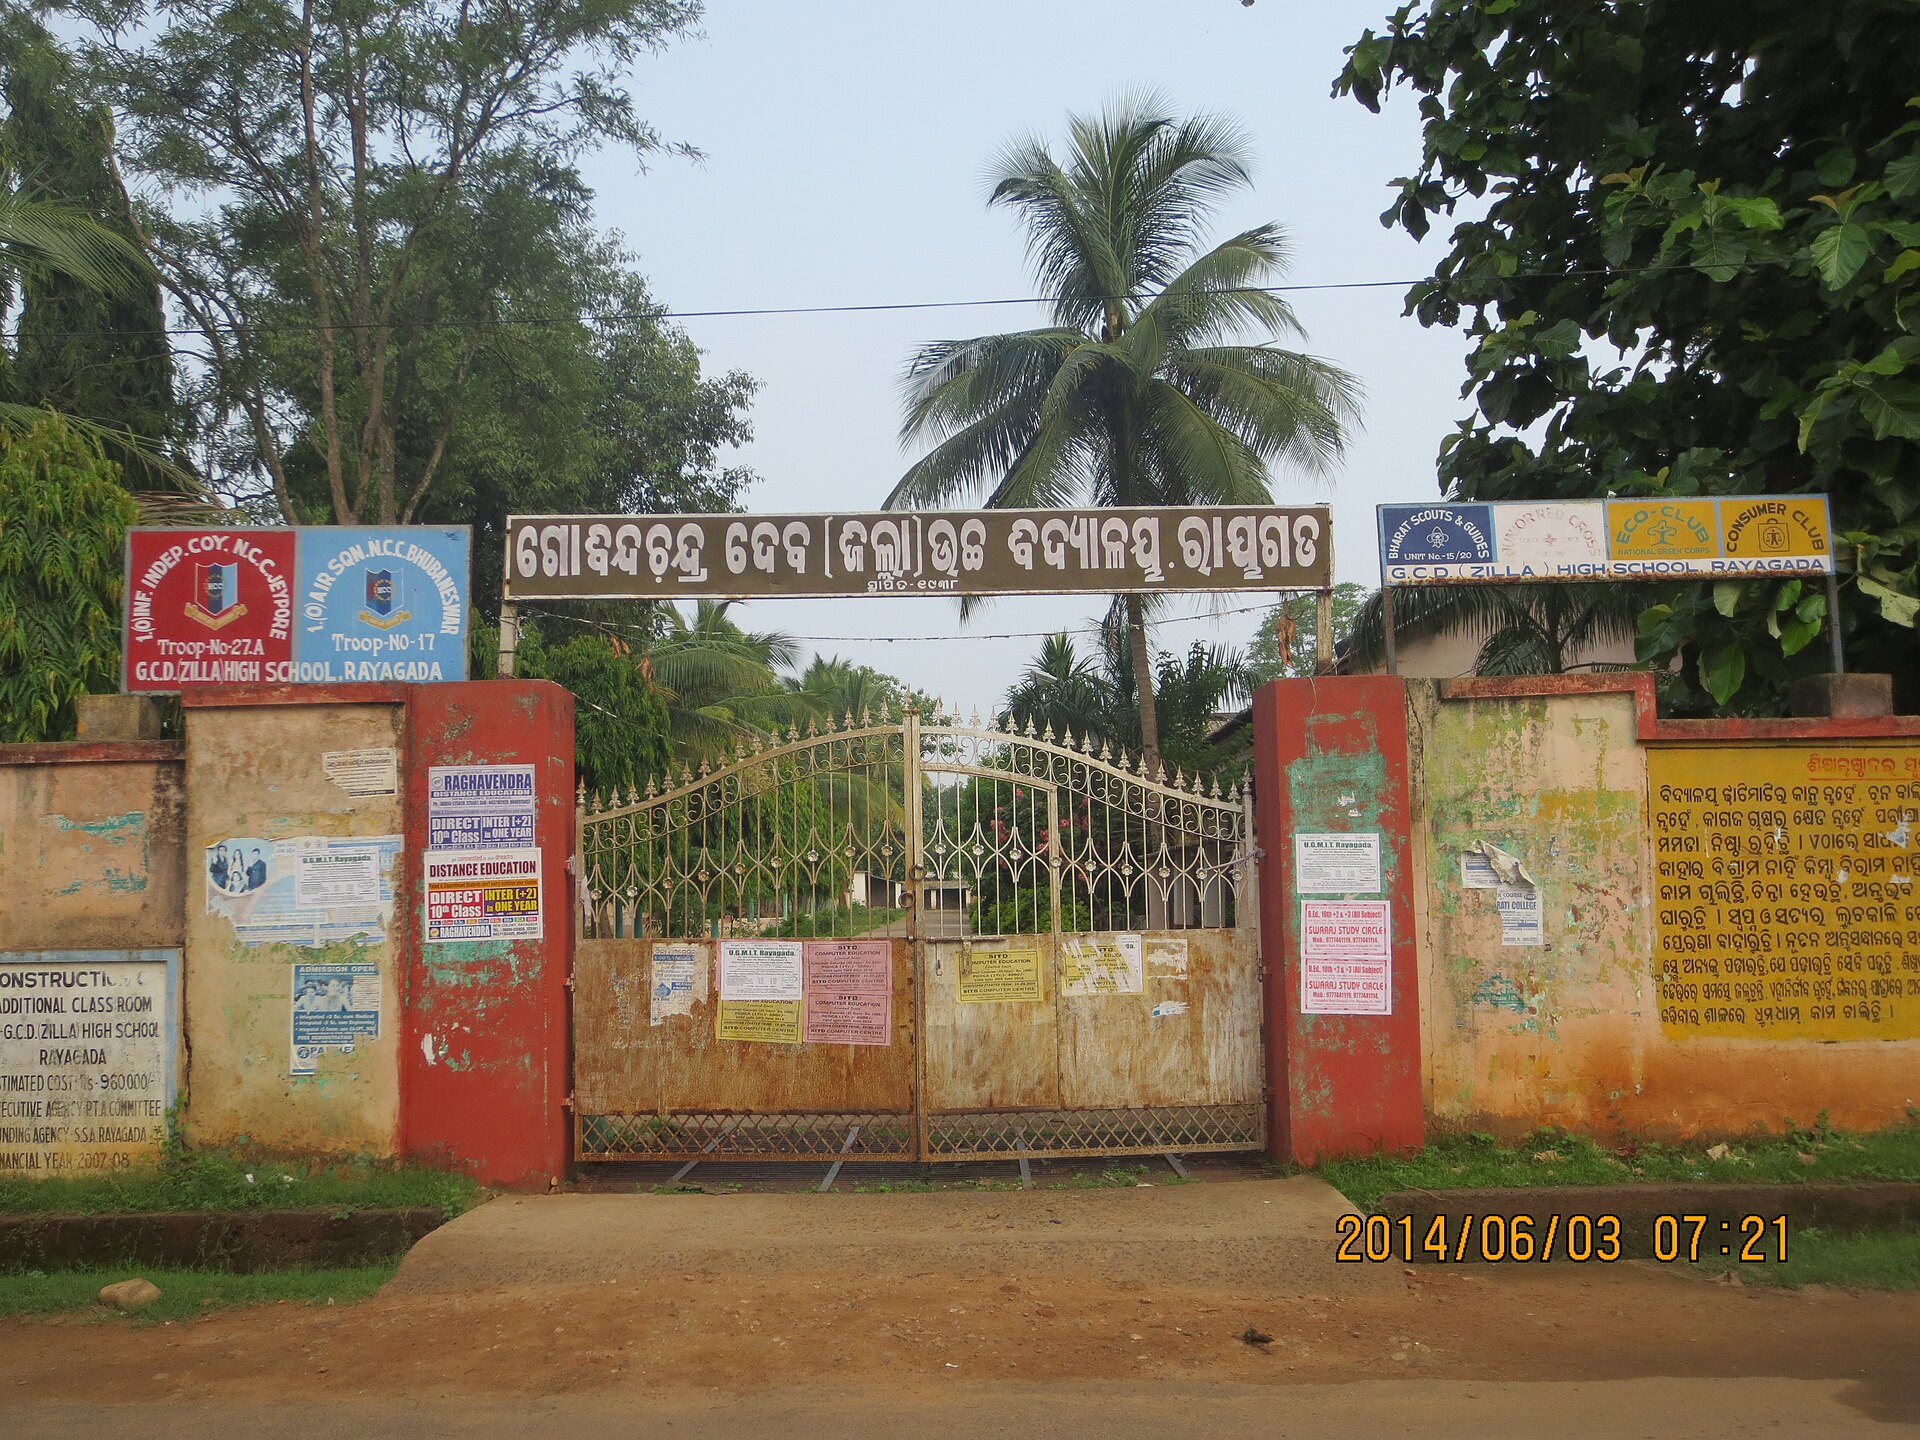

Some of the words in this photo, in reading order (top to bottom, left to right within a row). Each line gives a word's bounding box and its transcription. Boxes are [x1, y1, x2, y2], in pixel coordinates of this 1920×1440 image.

[1726, 502, 1787, 553] CONSUMER
[1792, 510, 1825, 551] CLUB
[1388, 520, 1412, 559] BHARAT
[1410, 509, 1454, 526] SCOUTS
[1454, 515, 1464, 527] &
[1463, 521, 1490, 559] GUIDES
[1404, 553, 1426, 561] UNIT
[1617, 548, 1654, 556] NATIONAL
[1684, 547, 1711, 555] CORPS
[1557, 563, 1607, 576] HIGH
[1711, 558, 1825, 573] RAYAGADA
[344, 661, 443, 681] RAYAGADA
[444, 773, 531, 789] RAGHAVENDRA
[432, 817, 480, 830] DIRECT
[482, 816, 509, 828] INTER
[453, 831, 480, 843] Class
[492, 828, 509, 838] ONE
[510, 828, 532, 838] YEAR
[429, 863, 478, 878] DISTANCE
[480, 860, 536, 876] EDUCATION
[430, 890, 481, 905] DIRECT
[484, 889, 512, 901] INTER
[452, 904, 481, 917] Class
[494, 901, 512, 912] ONE
[513, 900, 537, 911] YEAR
[1511, 901, 1536, 910] COLLEGE
[440, 926, 490, 938] RAGHAVENDRA
[1308, 926, 1337, 935] SWARAJ
[1338, 926, 1360, 935] STUDY
[1361, 926, 1383, 935] CIRCLE
[1308, 981, 1337, 990] SWARAJ
[1338, 981, 1360, 990] STUDY
[1361, 981, 1383, 990] CIRCLE
[72, 997, 113, 1013] CLASS
[117, 996, 152, 1012] ROOM
[82, 1022, 112, 1039] HIGH
